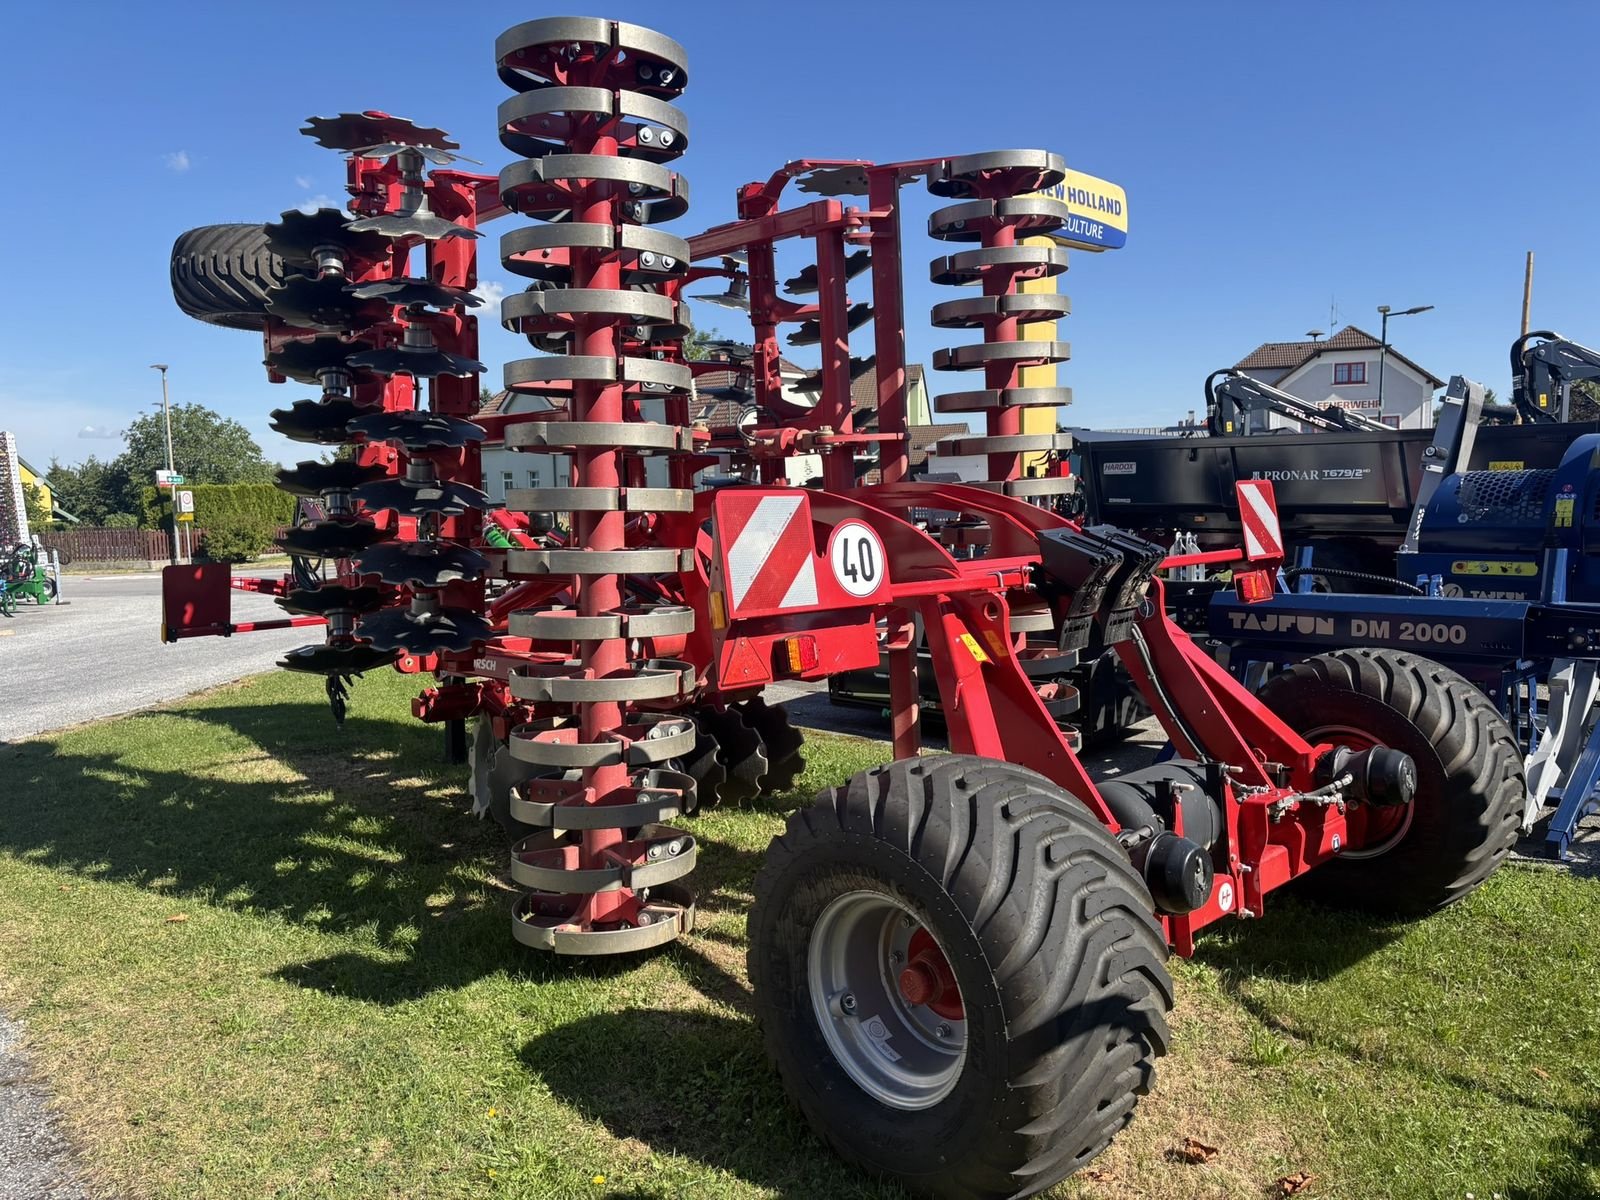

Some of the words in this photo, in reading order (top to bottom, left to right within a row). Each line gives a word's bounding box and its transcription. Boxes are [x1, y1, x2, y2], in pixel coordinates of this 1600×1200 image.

[1067, 186, 1121, 216] HOLLAND
[1062, 218, 1104, 239] ULTURE
[1285, 407, 1327, 428] PALMS
[1105, 463, 1134, 471] HARDOX
[1264, 470, 1320, 480] PRONAR
[842, 537, 875, 583] 40
[1228, 612, 1335, 635] TAJFUN
[1351, 619, 1390, 639] DM
[1399, 622, 1467, 644] 2000
